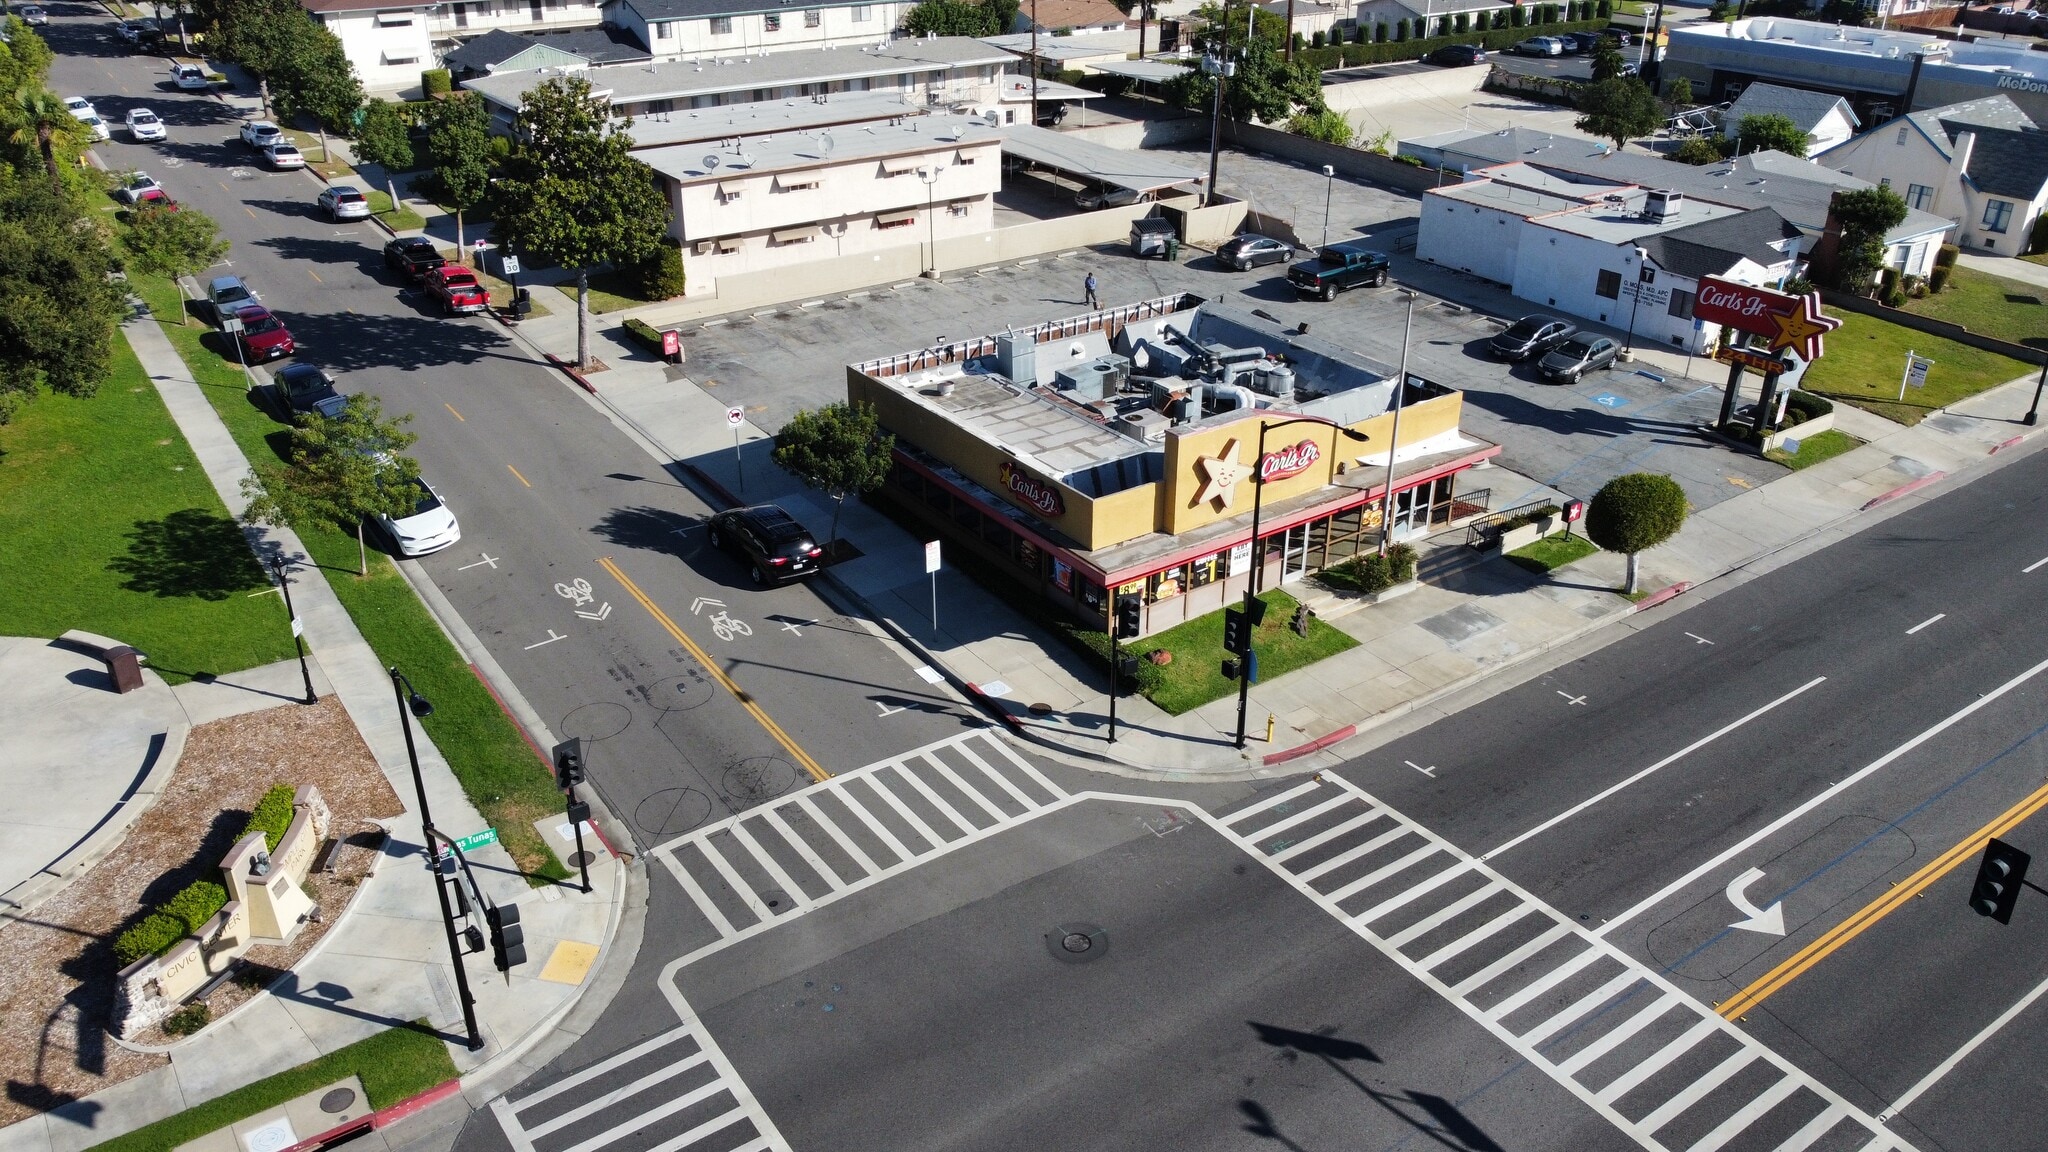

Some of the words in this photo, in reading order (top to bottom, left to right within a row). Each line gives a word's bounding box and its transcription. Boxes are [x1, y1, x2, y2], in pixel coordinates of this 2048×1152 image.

[1997, 75, 2048, 94] McDon
[506, 264, 518, 272] 30
[1657, 289, 1669, 297] APC
[1699, 285, 1742, 311] Carl's
[1742, 295, 1768, 318] Jr.
[1722, 348, 1747, 363] 24
[1752, 356, 1783, 374] HR
[1261, 448, 1298, 477] Carl's
[1297, 443, 1319, 467] Jr.
[1009, 473, 1040, 501] Carl's
[1039, 489, 1058, 513] Jr.
[1233, 552, 1249, 560] HERE
[467, 831, 494, 845] Tunas
[166, 951, 197, 978] CIVIC
[201, 912, 241, 952] CENTER
